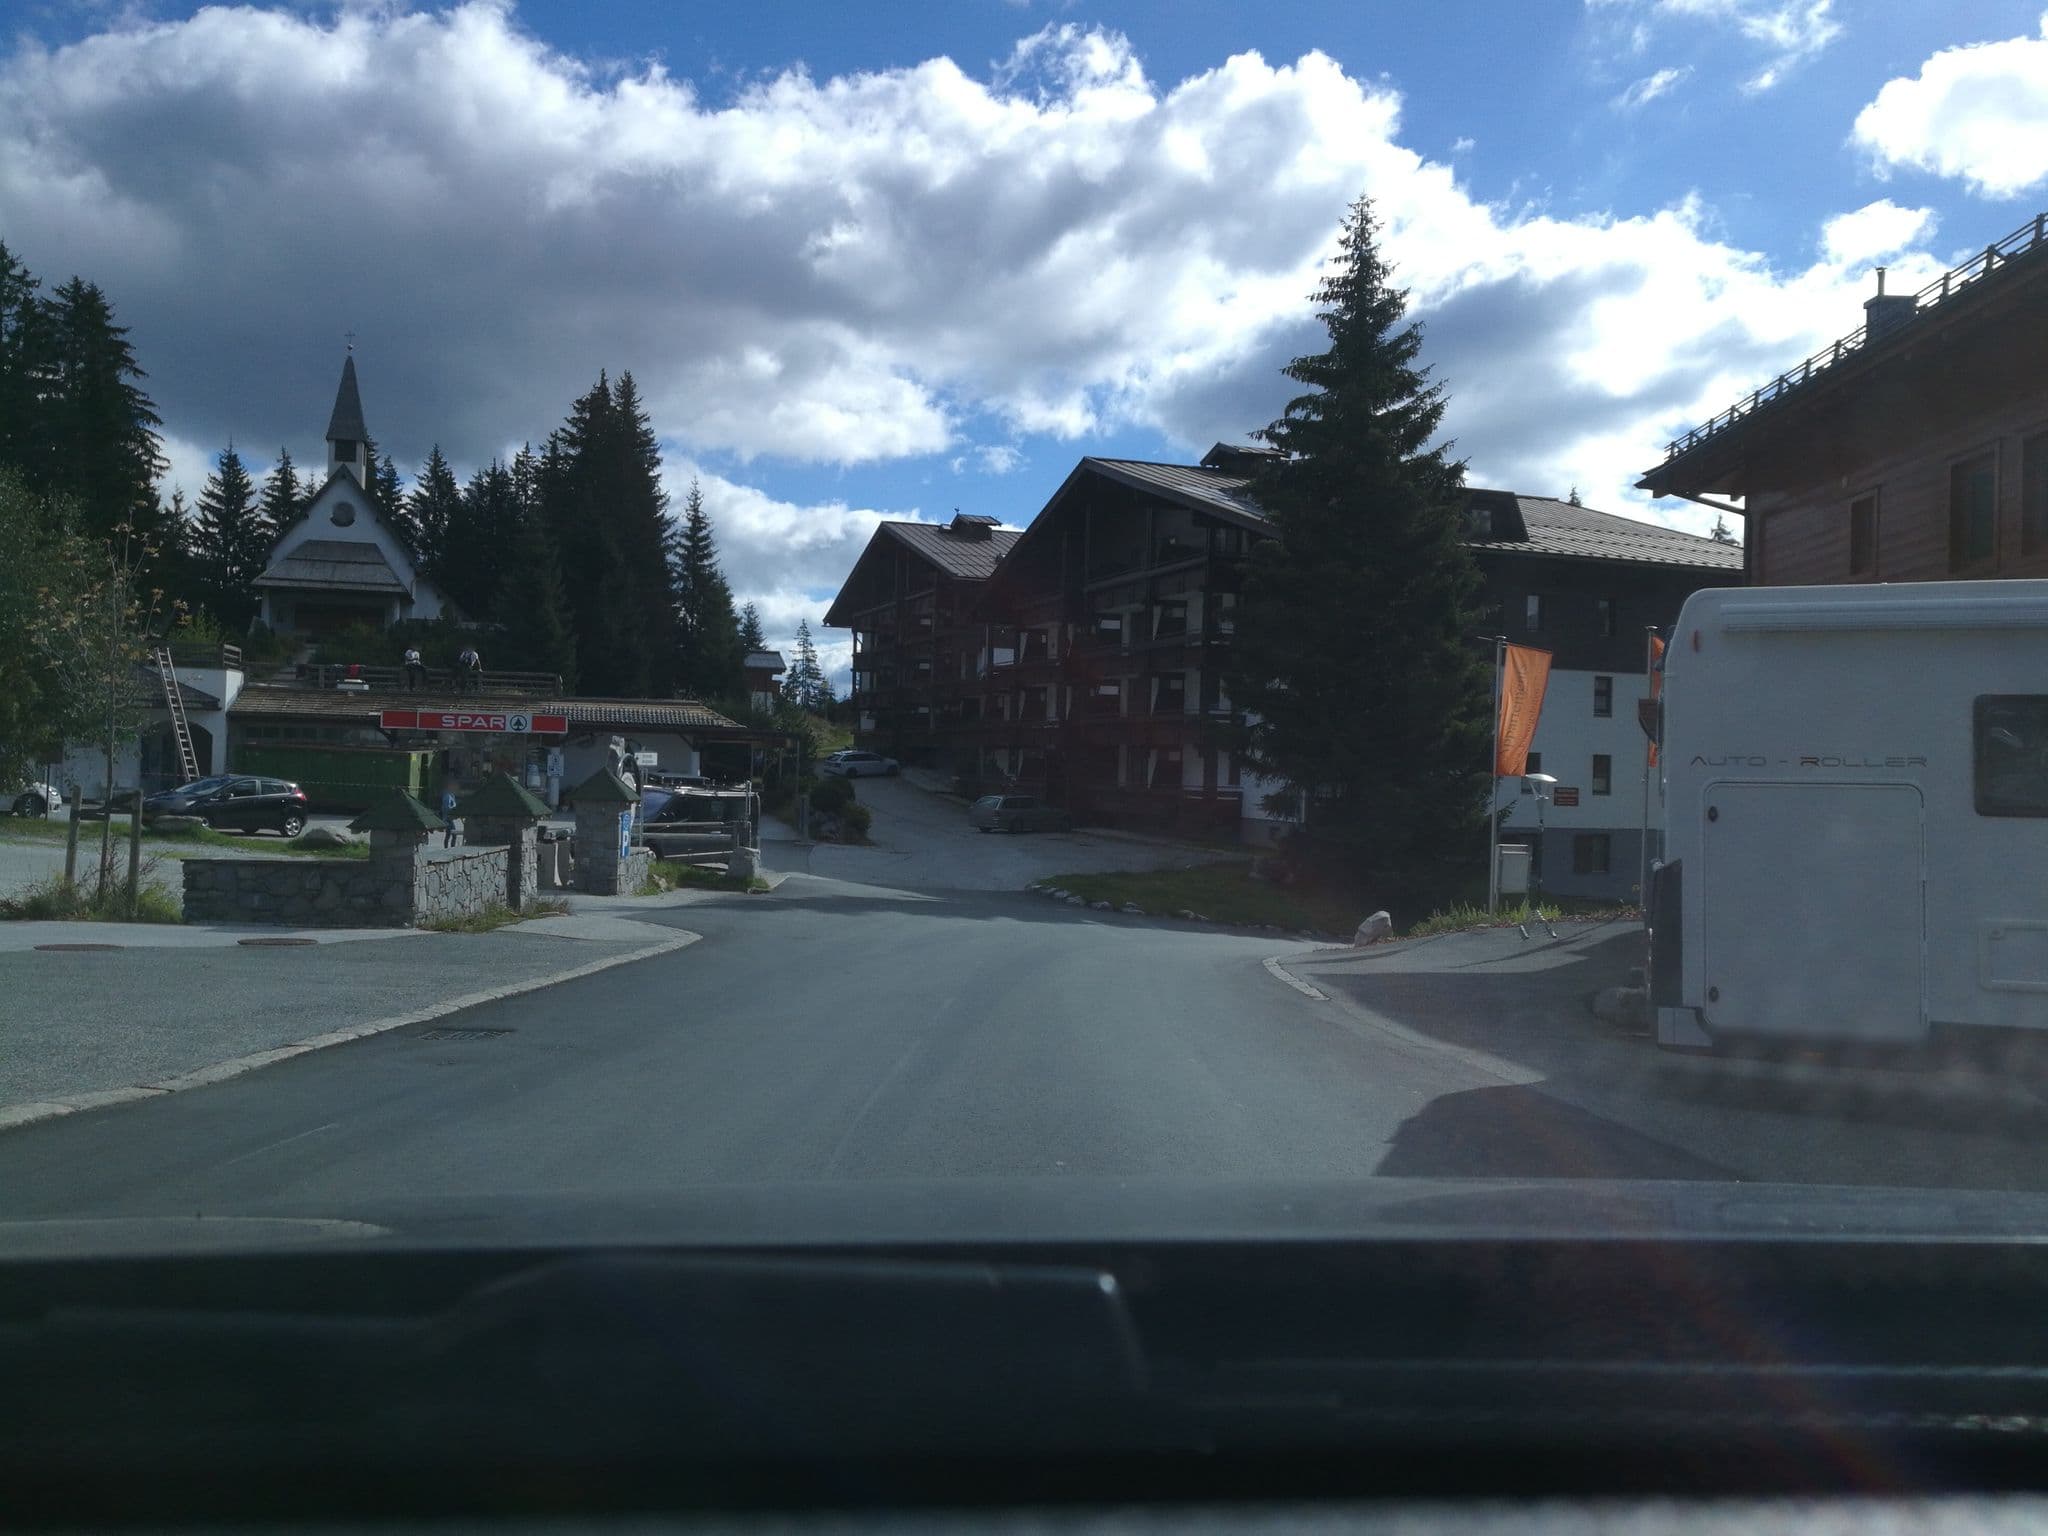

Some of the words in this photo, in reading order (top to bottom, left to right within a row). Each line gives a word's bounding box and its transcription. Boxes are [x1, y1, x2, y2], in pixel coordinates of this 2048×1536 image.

[442, 715, 505, 728] SPAR
[1690, 755, 1768, 767] AUTO
[1800, 756, 1928, 768] ROLLER
